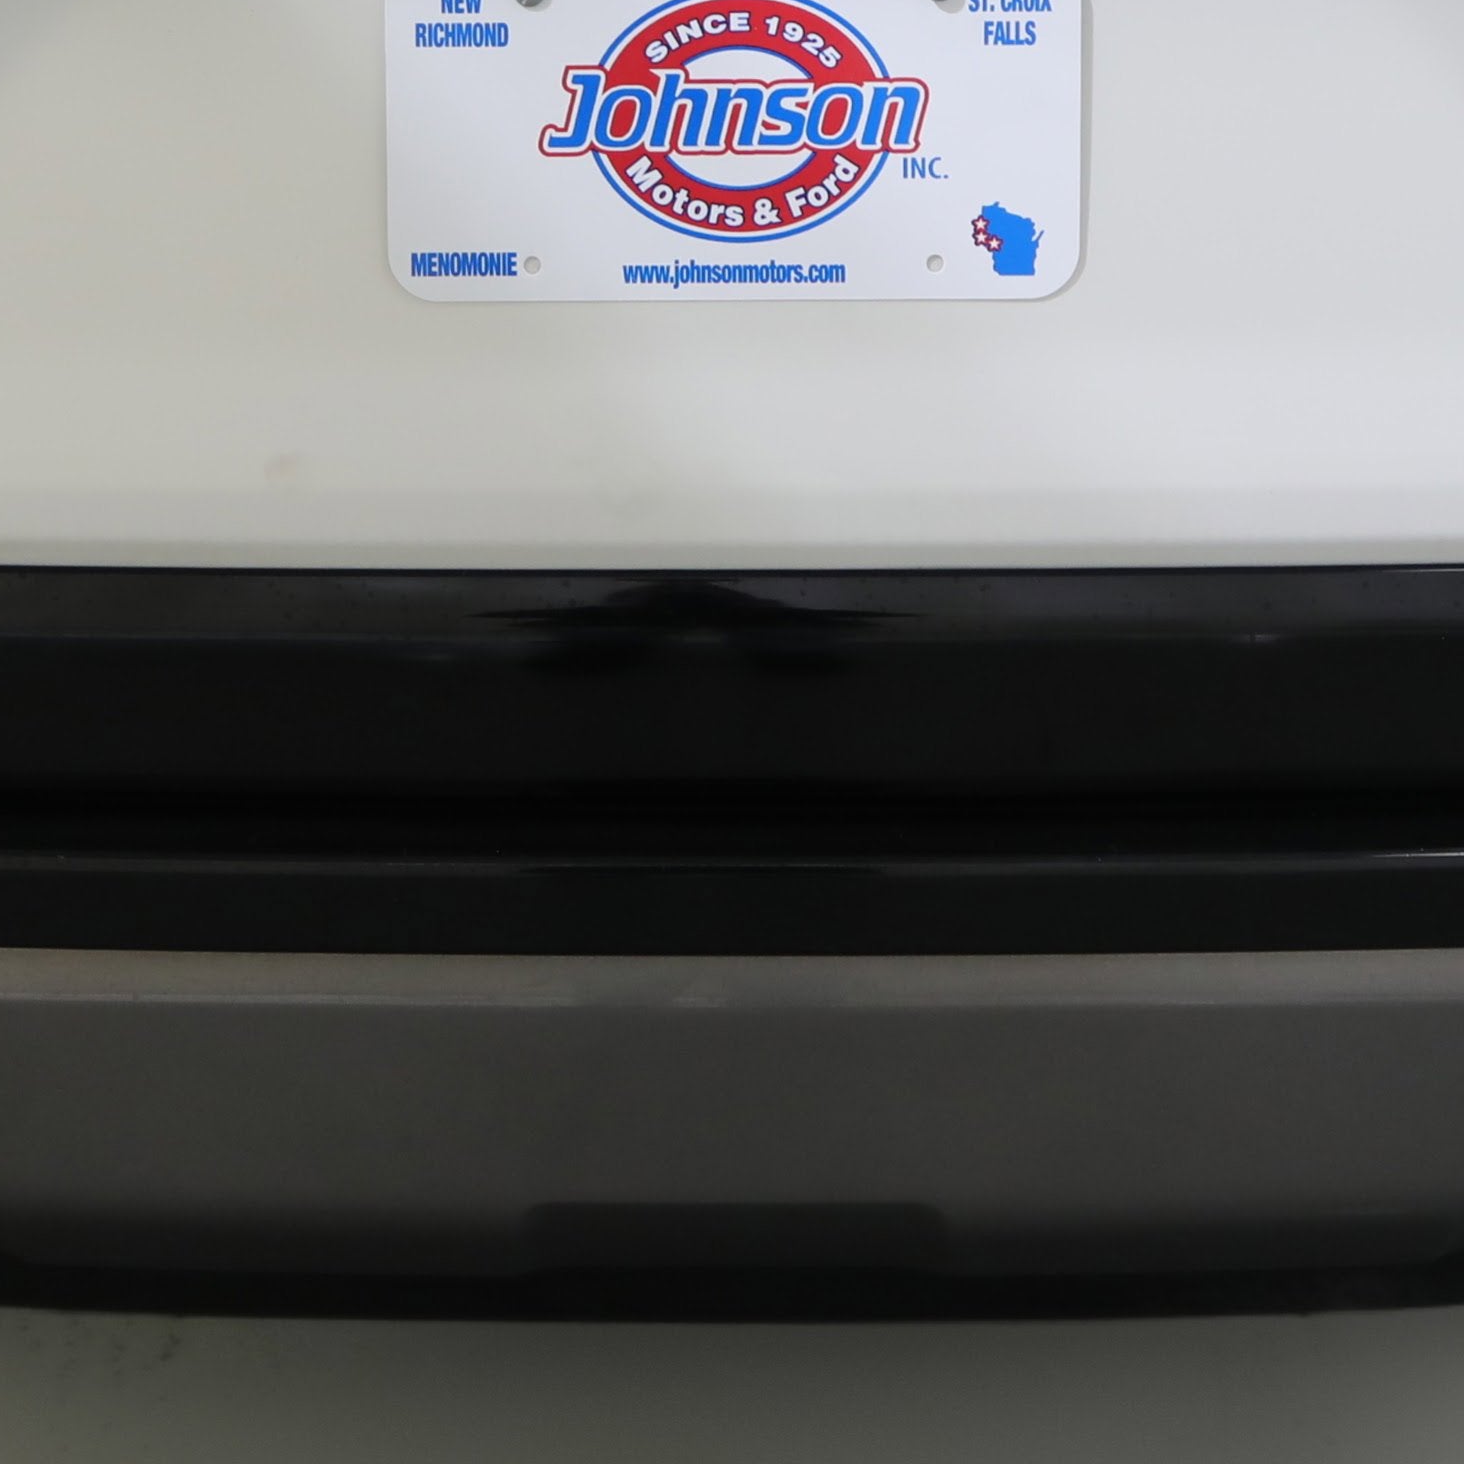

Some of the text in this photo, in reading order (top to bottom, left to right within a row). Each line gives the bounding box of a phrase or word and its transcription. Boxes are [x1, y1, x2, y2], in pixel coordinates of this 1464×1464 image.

[415, 22, 509, 48] RICHMOND
[645, 12, 842, 69] SINCE 1925
[984, 21, 1037, 45] FALLS
[543, 70, 925, 151] Johnson
[902, 157, 949, 179] INC.
[625, 154, 861, 226] Motors & Ford
[411, 252, 518, 277] MENOMONIE
[622, 259, 847, 289] www.johnsonmotors.com
